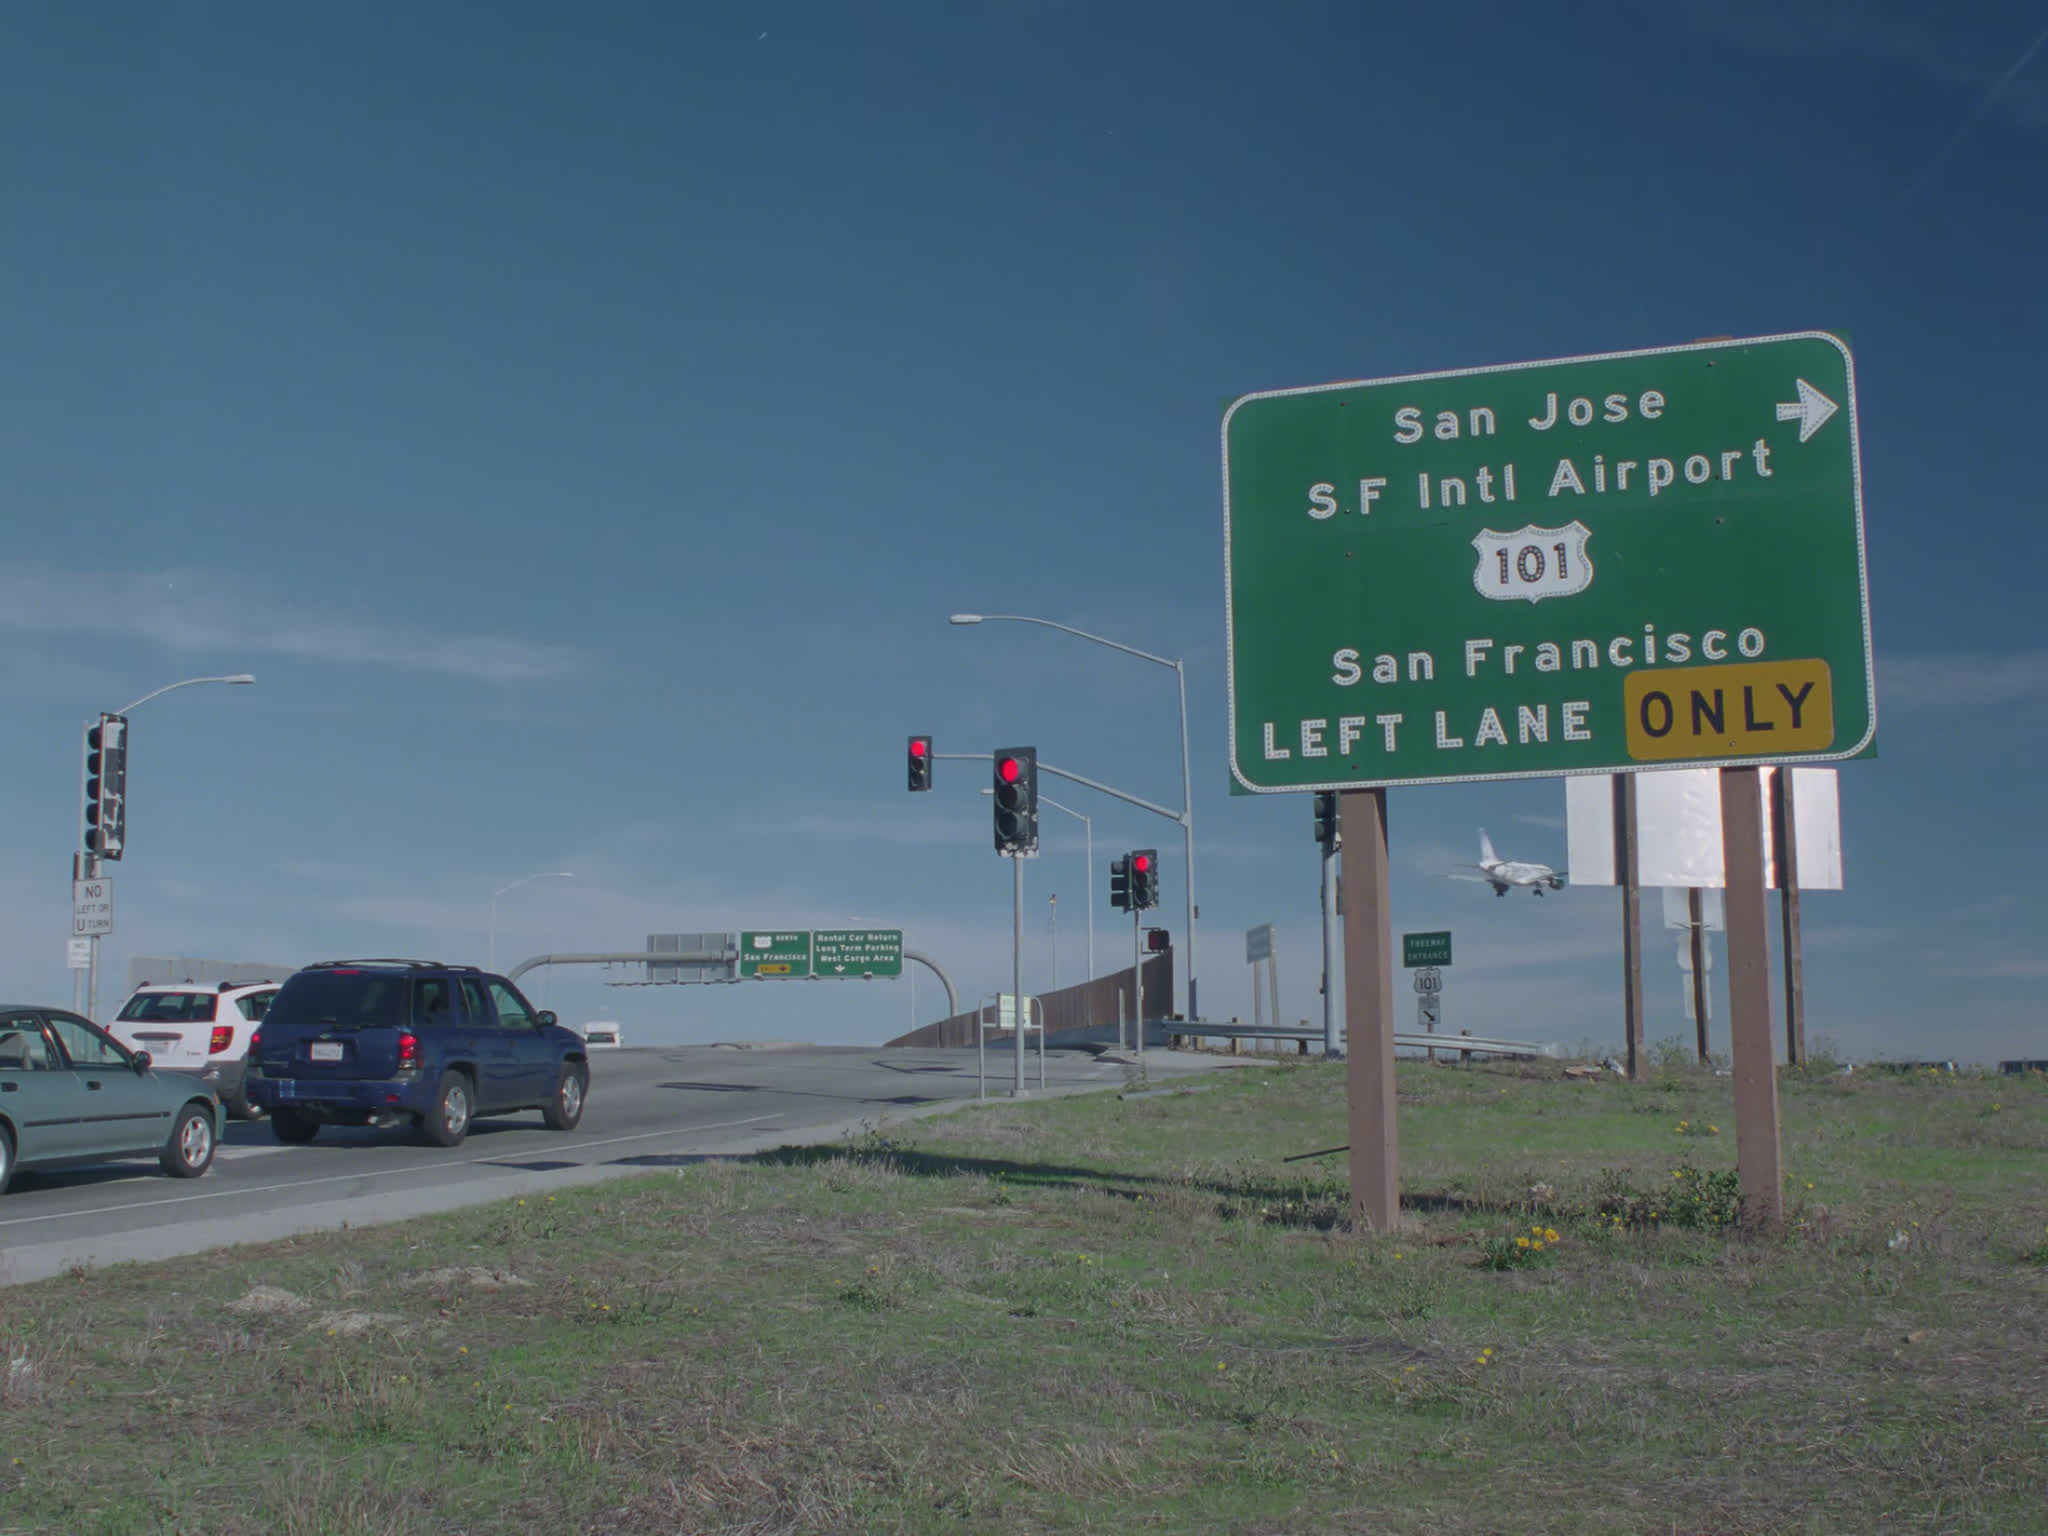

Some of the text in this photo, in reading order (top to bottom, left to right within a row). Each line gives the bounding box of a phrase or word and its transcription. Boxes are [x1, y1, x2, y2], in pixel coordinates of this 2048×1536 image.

[1394, 389, 1666, 445] San Jose
[1418, 463, 1517, 510] Intl
[1547, 438, 1773, 497] Airport
[1495, 541, 1572, 586] 101
[1331, 623, 1766, 688] San Francisco
[1263, 681, 1816, 761] LEFT LANE ONLY
[85, 885, 102, 898] NO
[77, 903, 109, 914] LEFT OR
[77, 919, 109, 931] U TURN
[817, 933, 899, 942] Rental Car Return
[815, 943, 900, 954] Long Term Parking
[744, 952, 807, 961] San Francisco
[820, 954, 895, 964] West Cargo Area
[1407, 951, 1449, 961] ENTRANCE
[1419, 977, 1438, 991] 101
